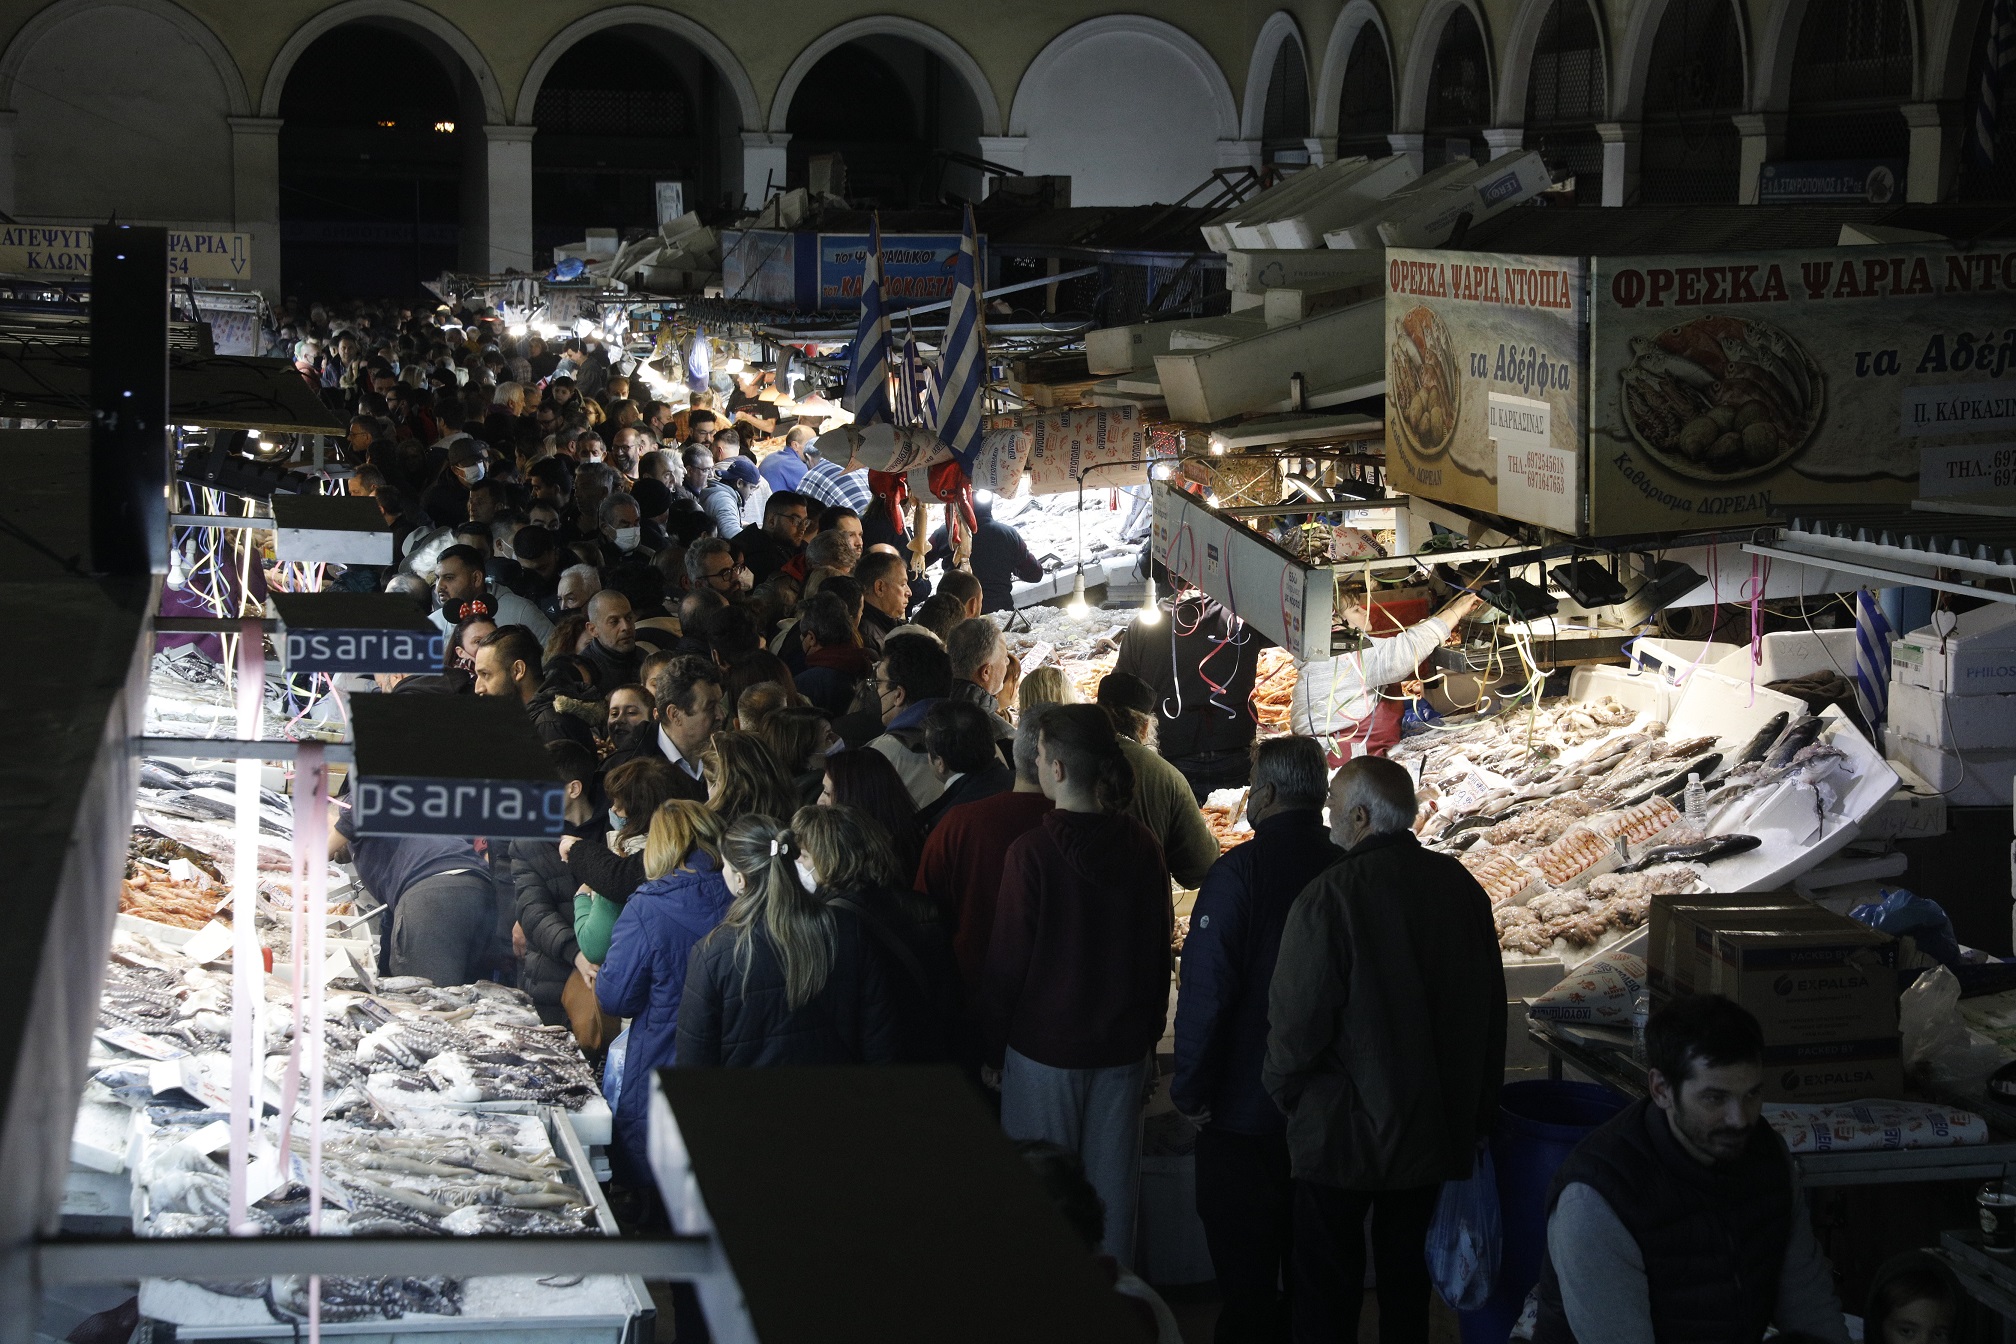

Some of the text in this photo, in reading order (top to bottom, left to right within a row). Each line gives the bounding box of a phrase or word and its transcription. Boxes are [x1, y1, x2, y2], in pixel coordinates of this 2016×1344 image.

[0, 227, 229, 254] ΑΤΕΨΥΓ ΨΑΡΙΑ
[27, 251, 93, 271] ΚΛΩΝ
[1389, 258, 1572, 309] ΦΡΕΣΚΑ ΨΑΡΙΑ ΝΤΟΠΙΑ
[1612, 264, 1789, 308] ΦΡΕΣΚΑ
[1801, 257, 1934, 300] ΨΑΡΙΑ
[1470, 343, 1571, 396] τα Αδέλφια
[1853, 349, 1902, 378] τα
[1914, 403, 1931, 422] Π.
[1131, 432, 1142, 471] ΙΧΥΟΠΩΛΕΙΟ
[1416, 467, 1443, 486] ΔΩΡΕΑΝ
[1613, 452, 1773, 515] Καθάρισμα ΔΩΡΕΑΝ
[1791, 950, 1849, 961] PACKED BY
[1798, 976, 1870, 992] EXPALSA
[1797, 1045, 1855, 1056] PACKED BY
[1804, 1070, 1874, 1085] EXPALSA
